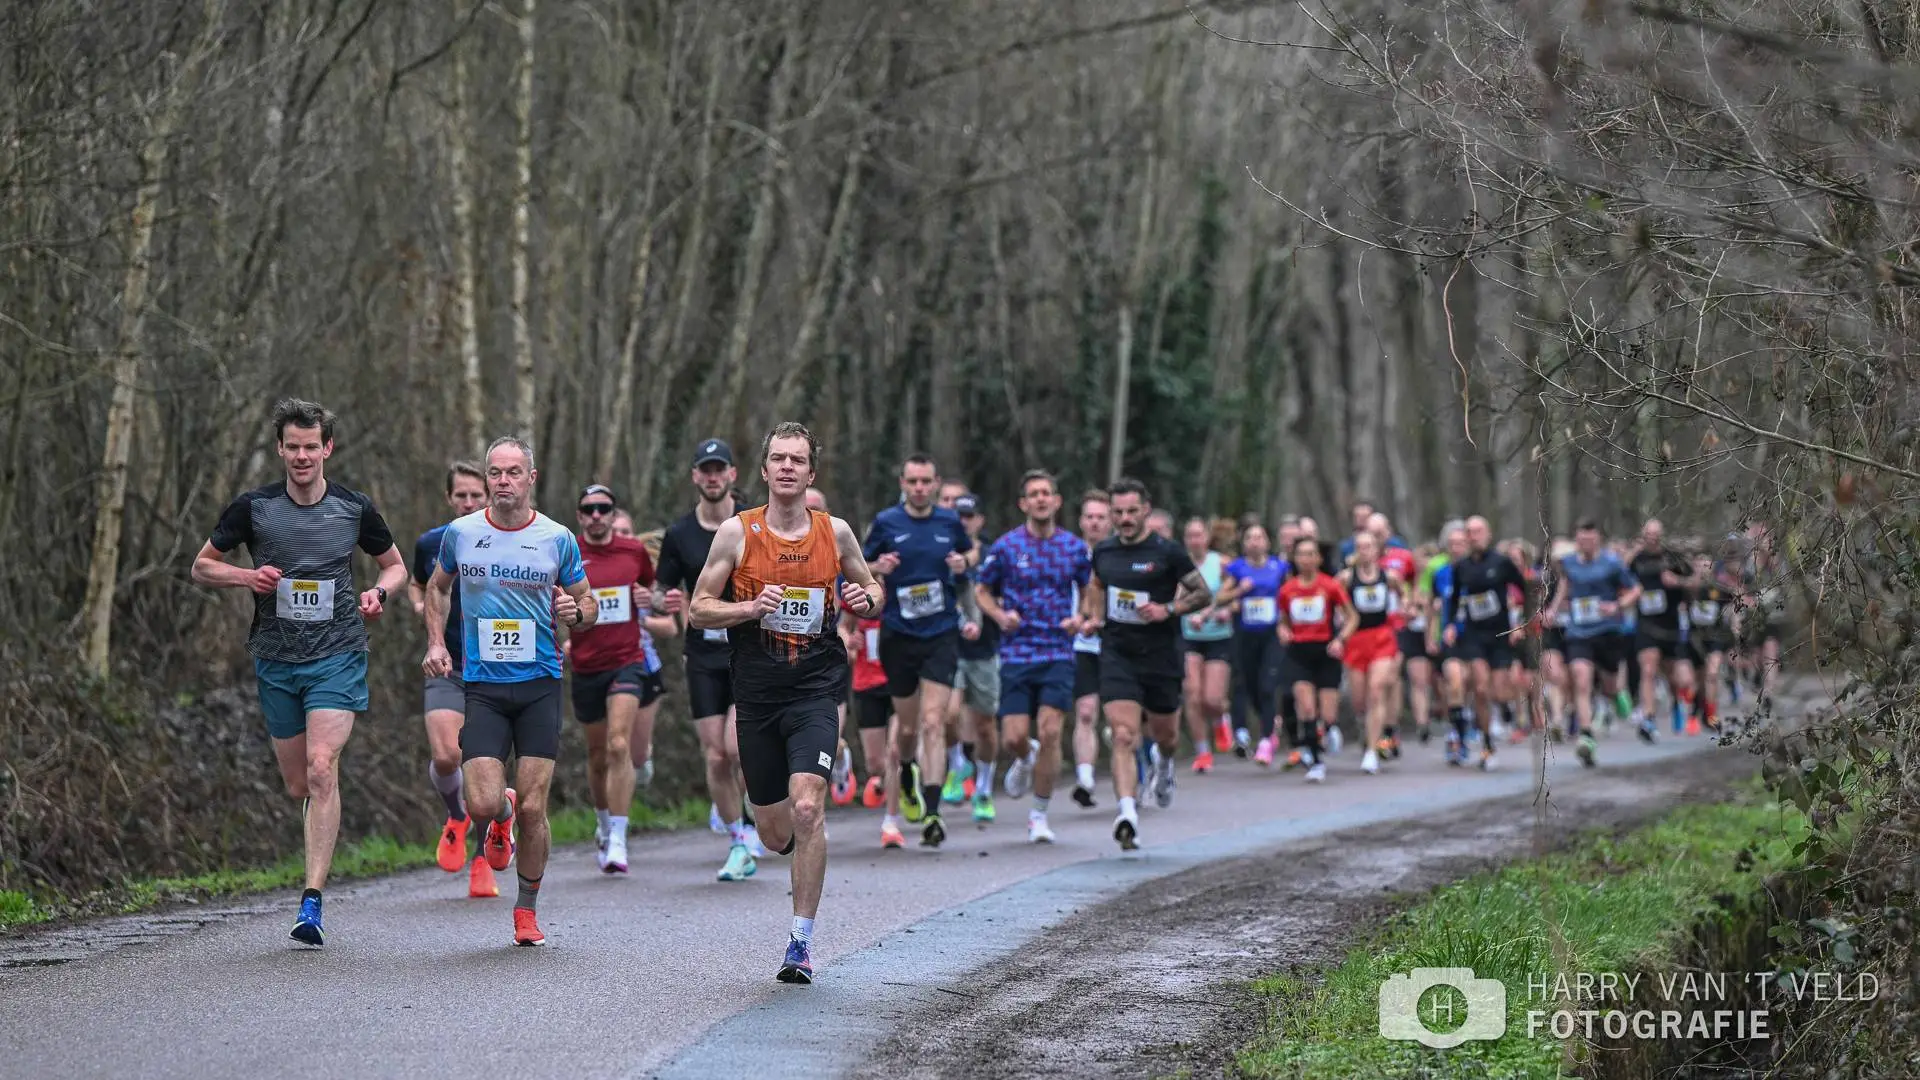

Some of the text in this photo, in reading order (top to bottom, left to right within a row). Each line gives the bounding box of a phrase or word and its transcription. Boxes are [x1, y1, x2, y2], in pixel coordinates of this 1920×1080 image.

[778, 553, 809, 561] Altis
[461, 563, 548, 582] Bos Bedden
[292, 592, 319, 605] 110
[599, 598, 619, 610] 132
[781, 600, 809, 616] 136
[493, 632, 520, 645] 212
